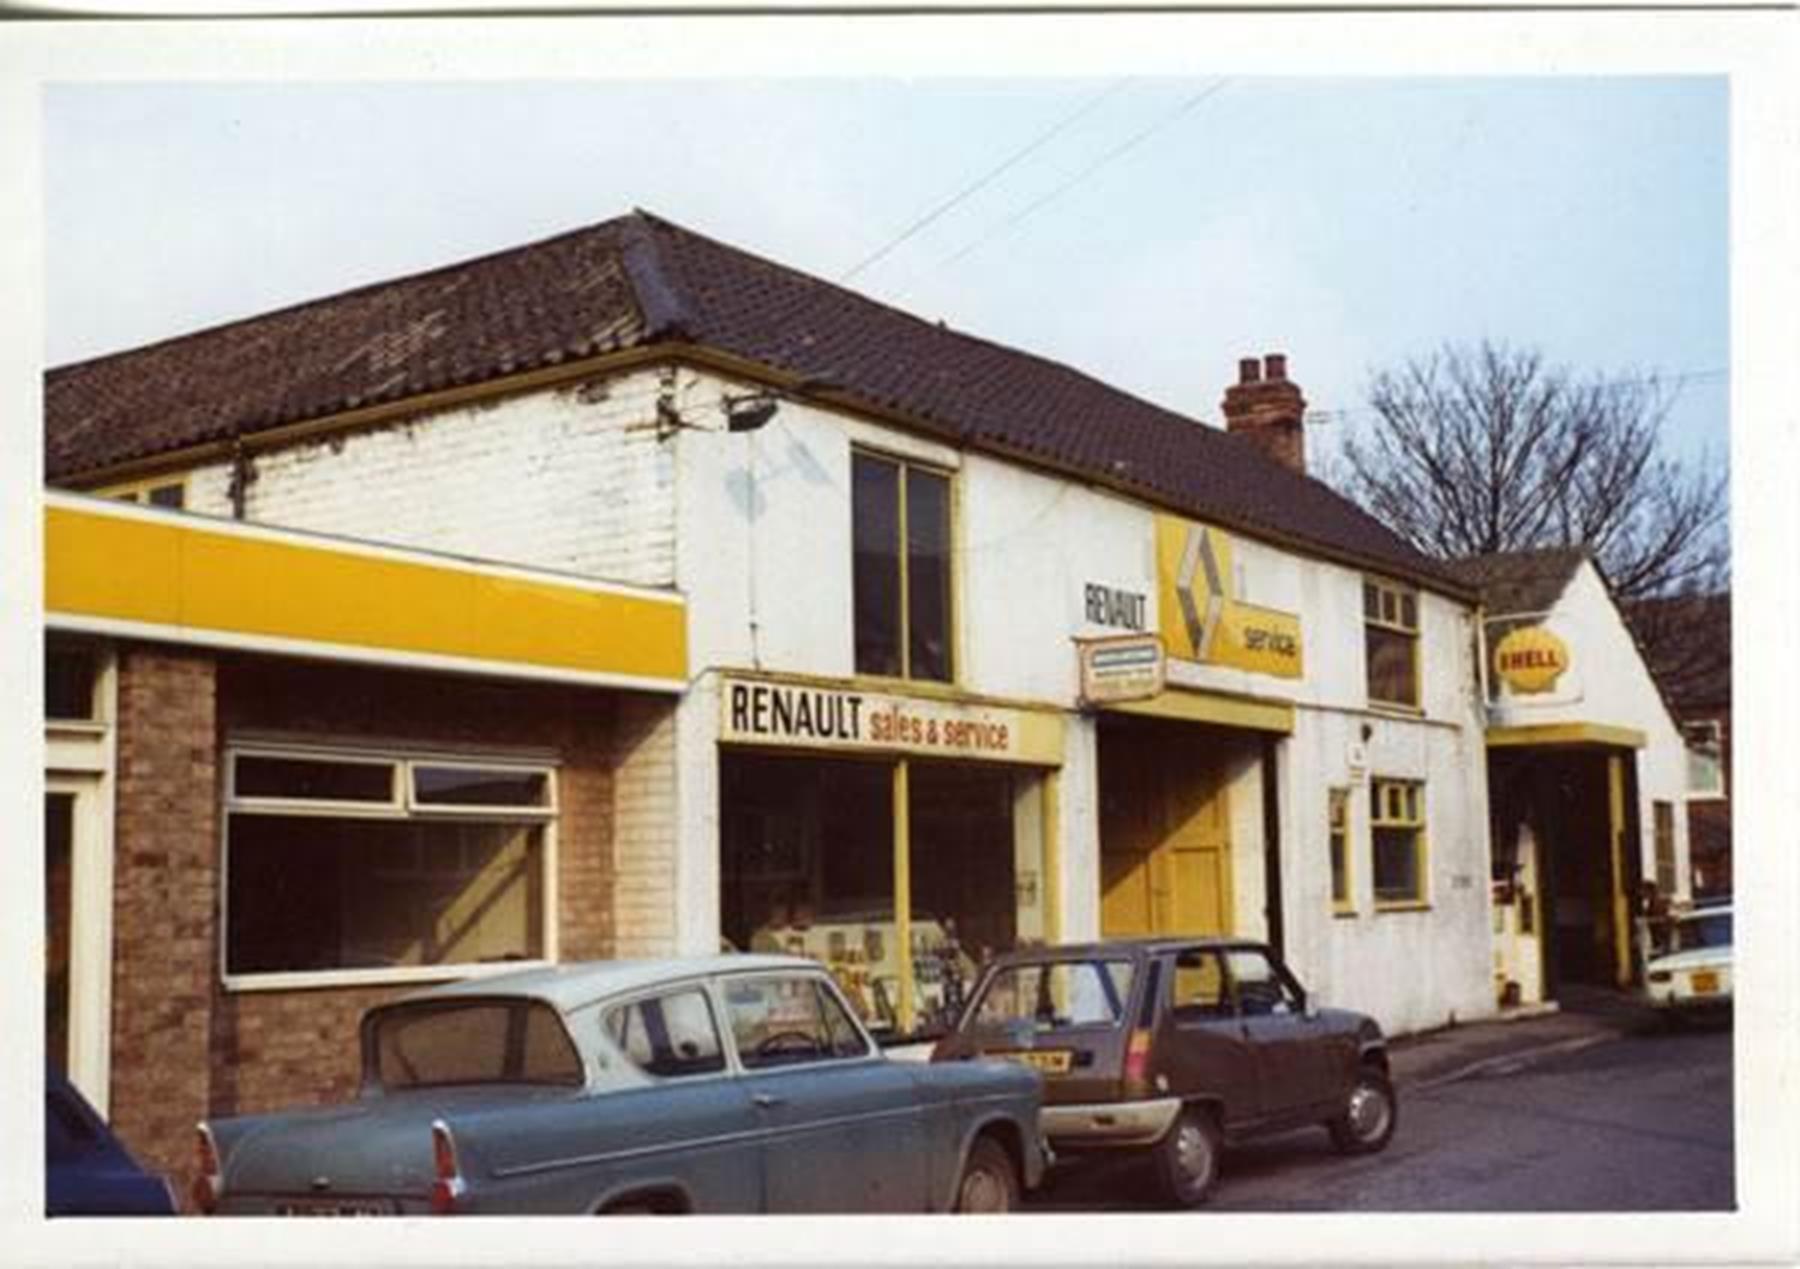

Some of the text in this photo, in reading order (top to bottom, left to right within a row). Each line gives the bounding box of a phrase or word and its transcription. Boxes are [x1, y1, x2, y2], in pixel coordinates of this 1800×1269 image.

[1085, 582, 1147, 631] RENAULT
[1244, 623, 1296, 658] service
[731, 684, 1010, 750] RENAULT sales & service
